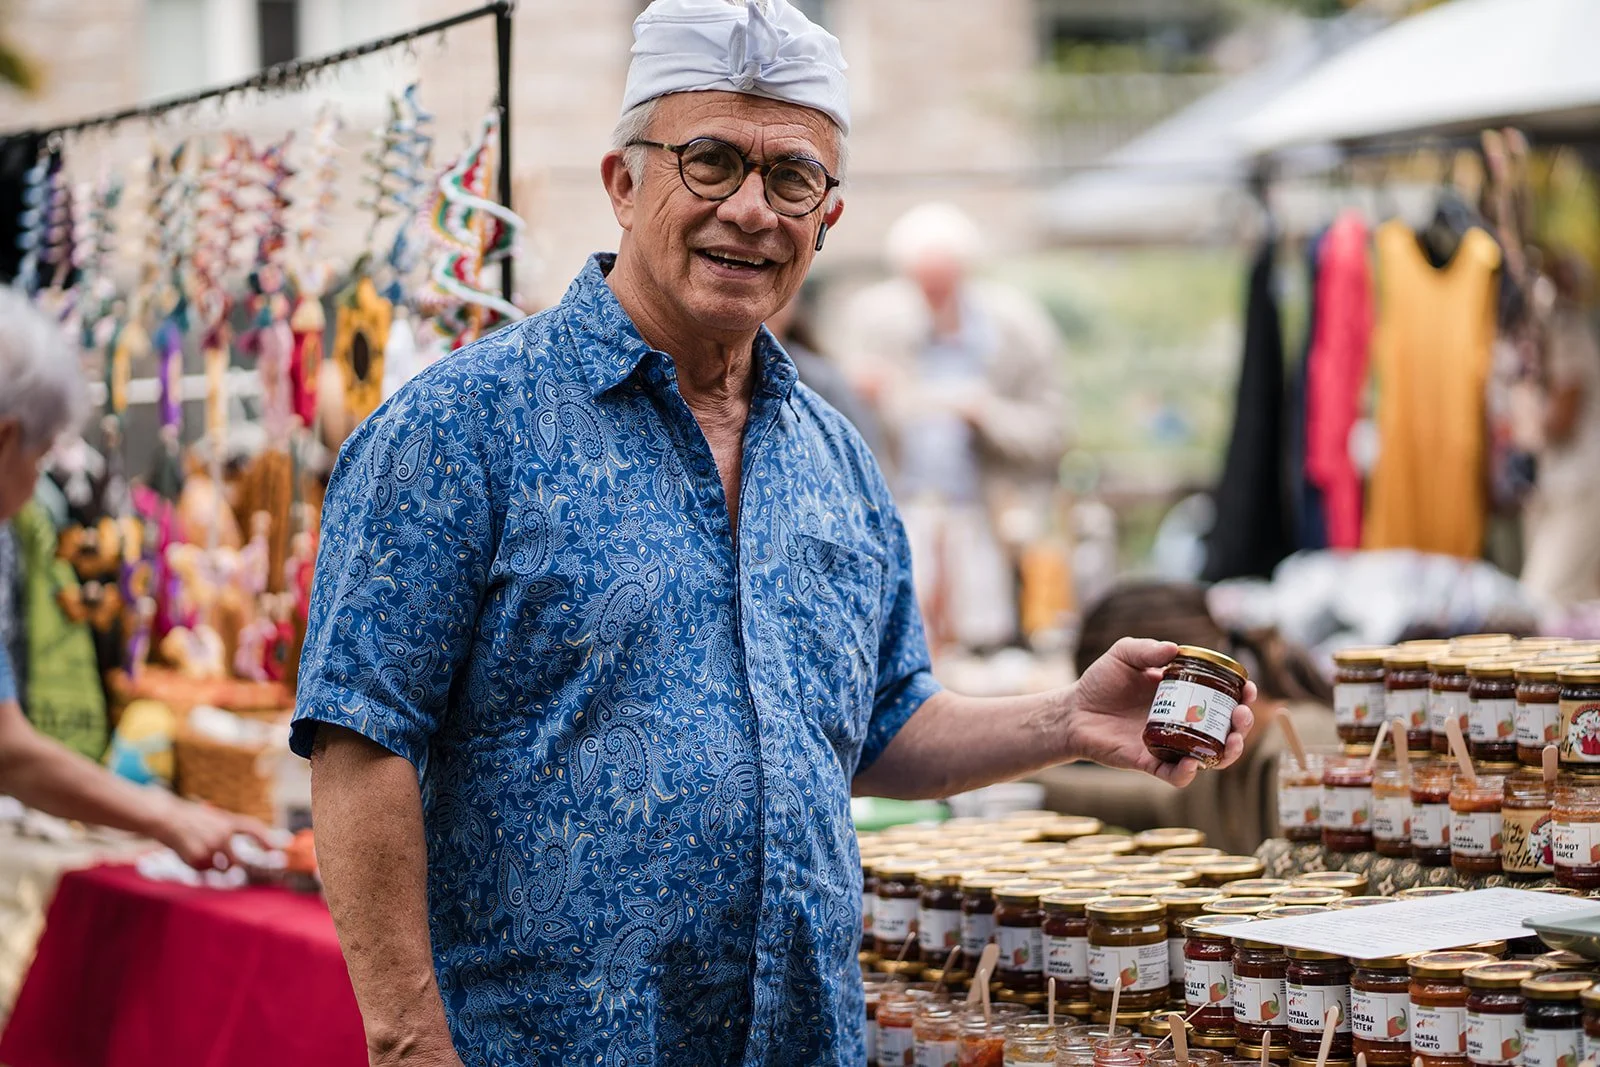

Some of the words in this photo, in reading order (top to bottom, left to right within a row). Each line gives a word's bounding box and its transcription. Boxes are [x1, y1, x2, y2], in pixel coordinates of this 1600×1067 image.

[1353, 1021, 1373, 1032] PETEH
[1415, 1033, 1439, 1042] SAMBAL
[1415, 1040, 1441, 1050] PICANTO
